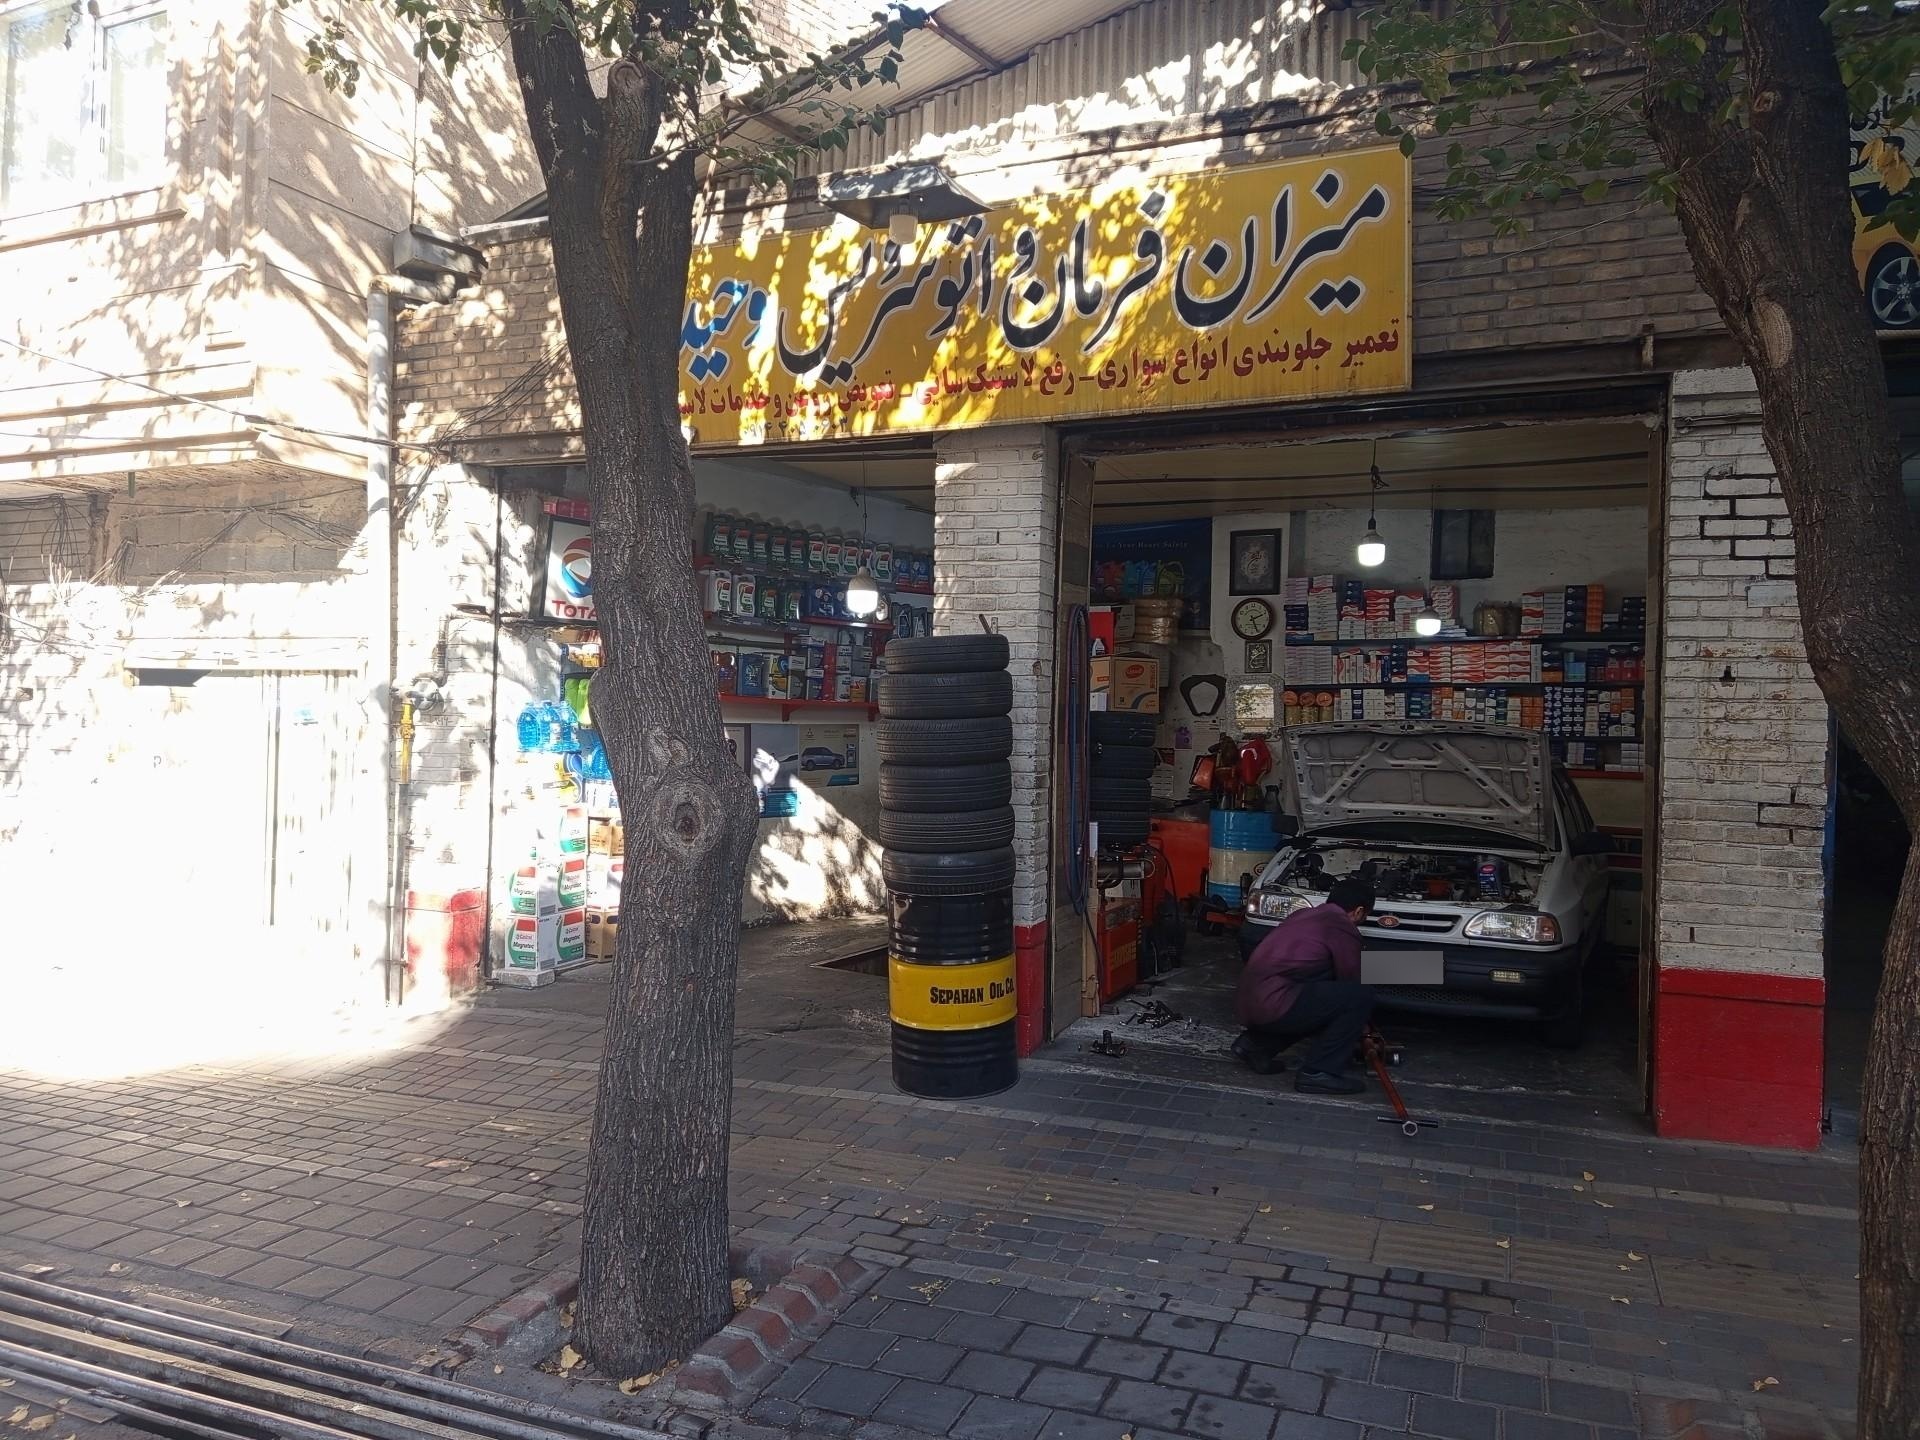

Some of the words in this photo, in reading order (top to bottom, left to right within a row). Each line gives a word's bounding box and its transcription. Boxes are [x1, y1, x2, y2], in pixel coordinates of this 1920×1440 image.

[1001, 190, 1167, 353] فرمان
[1173, 170, 1388, 329] میزان
[1172, 335, 1229, 386] انواع
[1233, 327, 1333, 377] جلوبندی
[1340, 317, 1400, 368] تعمیر
[1039, 352, 1075, 396] رفع
[552, 599, 599, 620] TOTA
